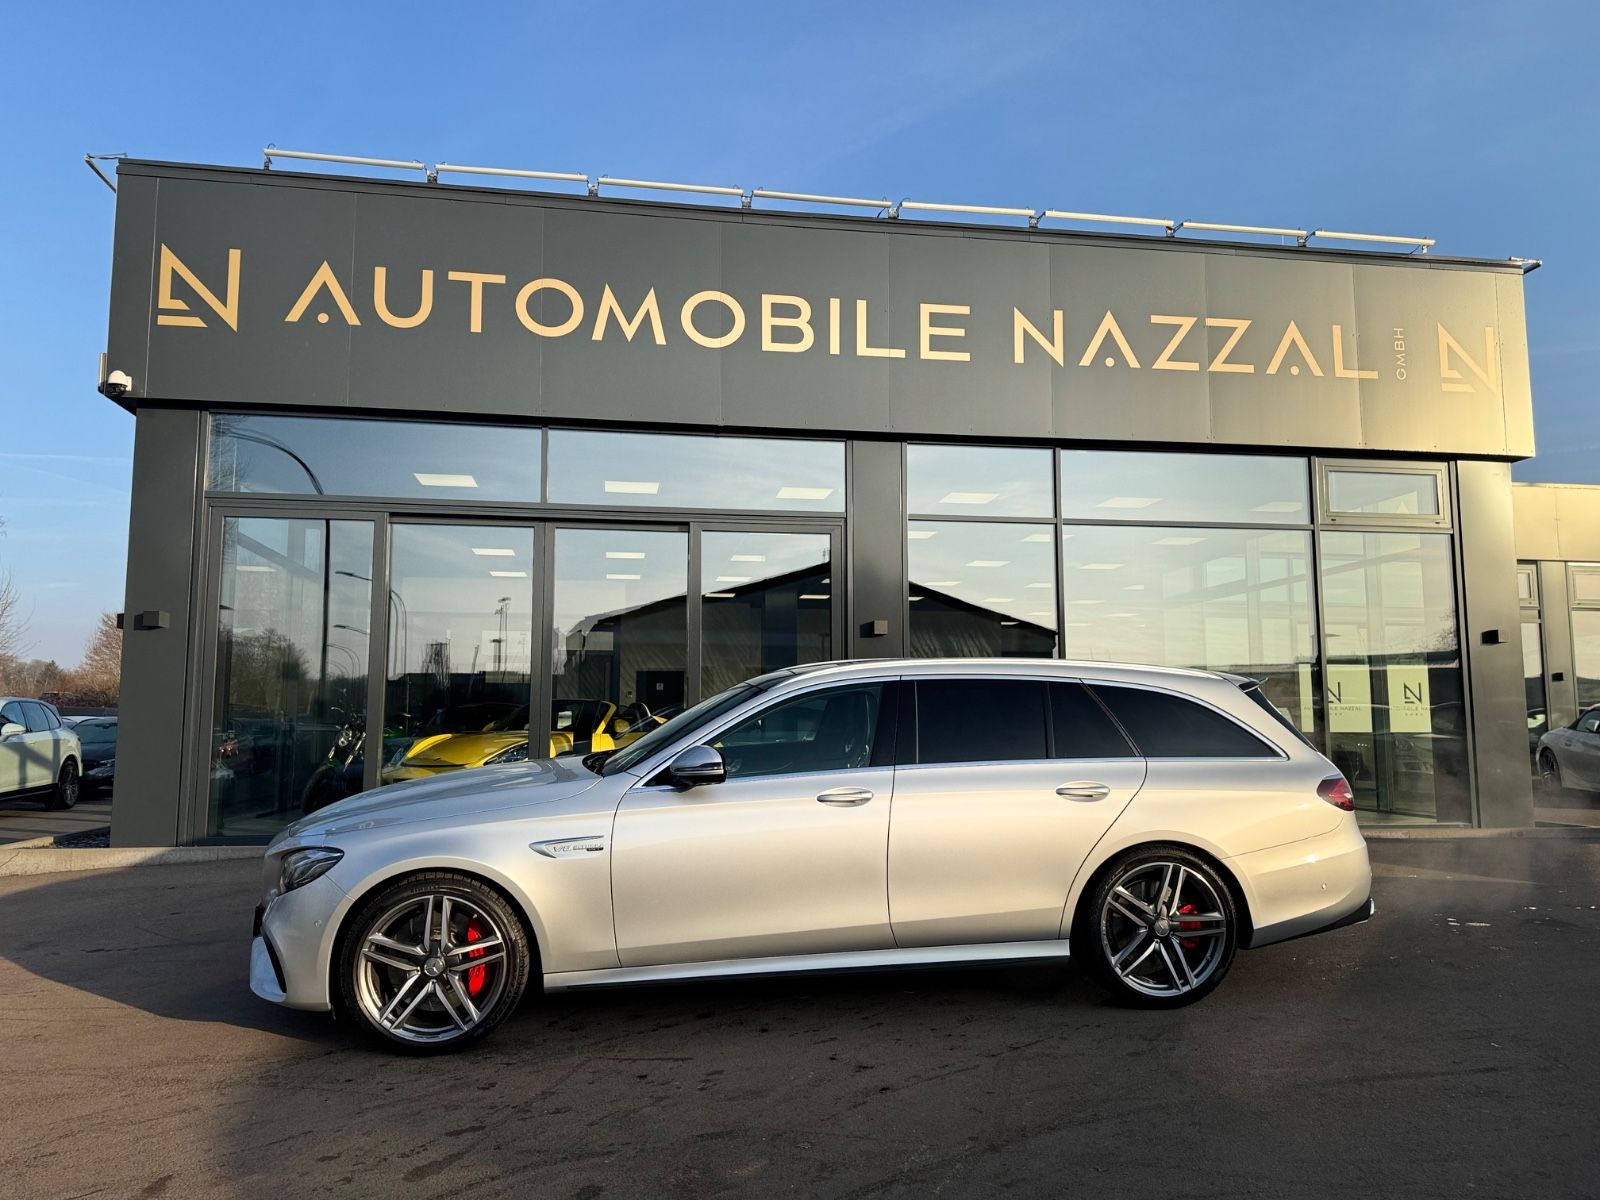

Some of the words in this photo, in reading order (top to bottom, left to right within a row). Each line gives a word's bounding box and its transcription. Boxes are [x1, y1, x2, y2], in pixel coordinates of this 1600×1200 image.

[284, 260, 972, 363] AUTOMOBILE
[1013, 306, 1379, 380] NAZZAL
[1393, 327, 1407, 381] GMBH
